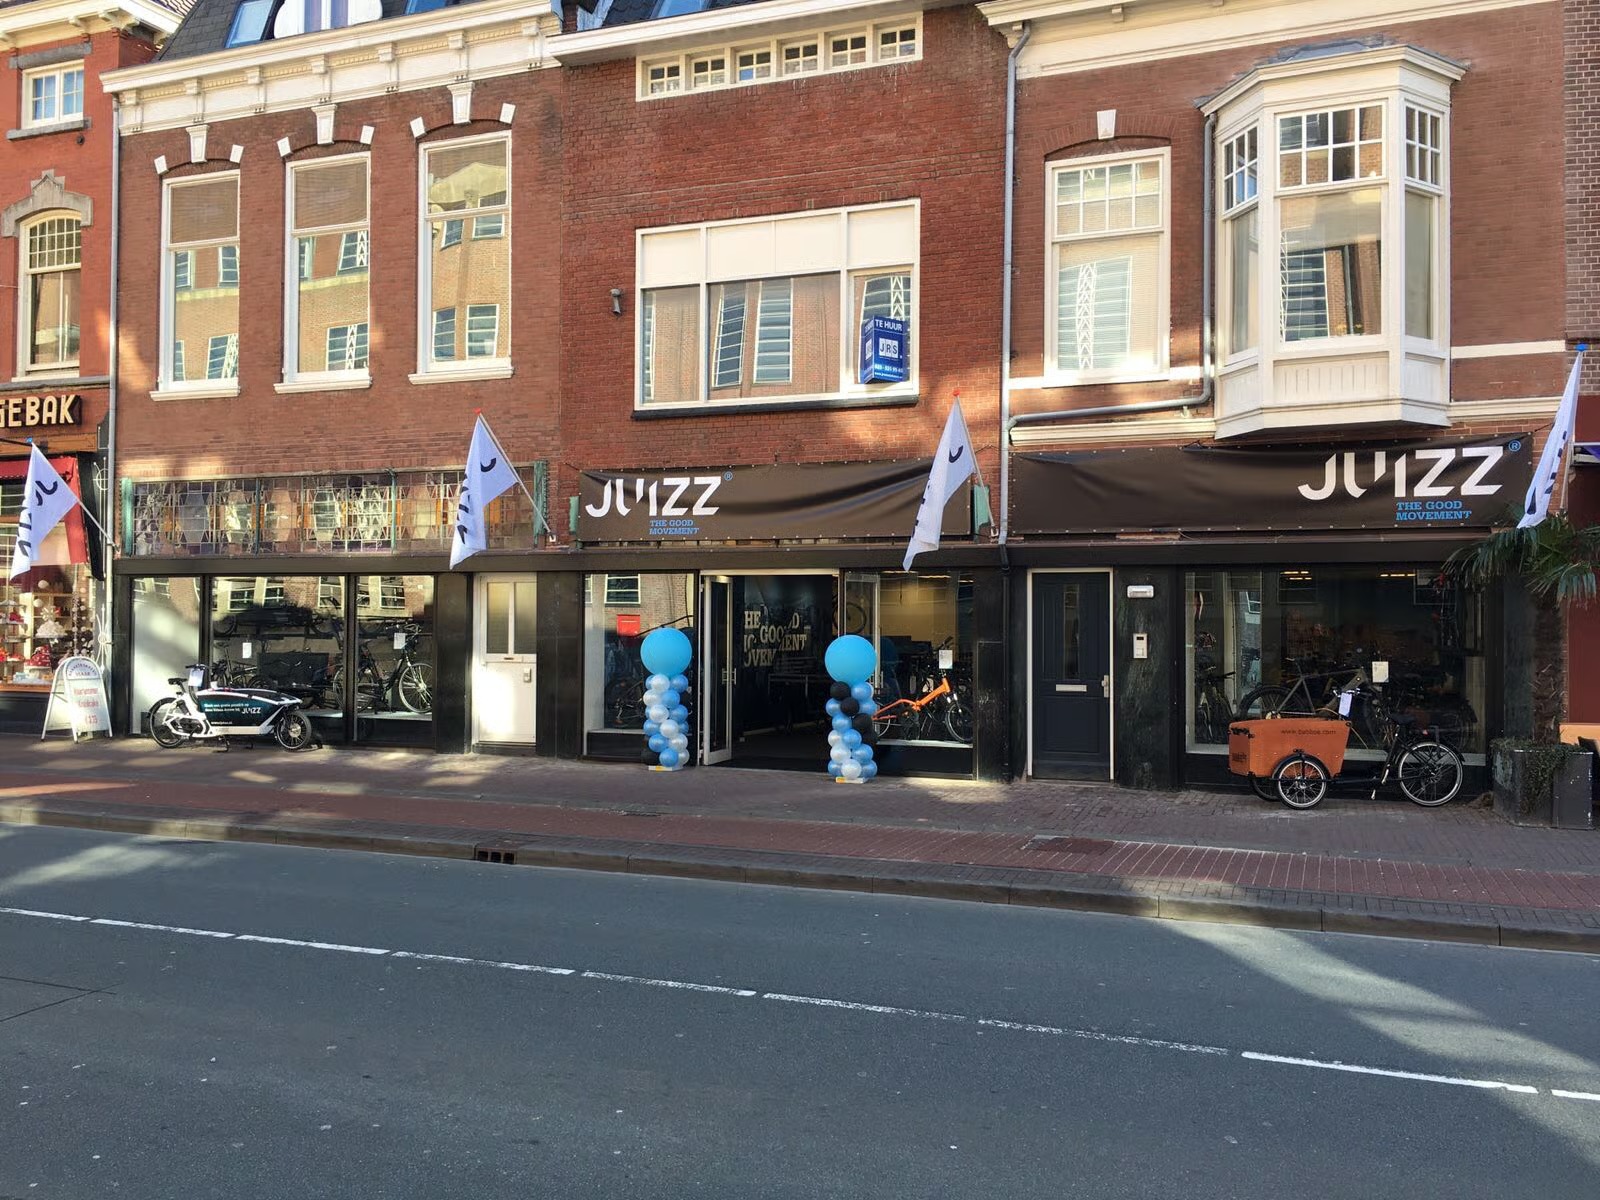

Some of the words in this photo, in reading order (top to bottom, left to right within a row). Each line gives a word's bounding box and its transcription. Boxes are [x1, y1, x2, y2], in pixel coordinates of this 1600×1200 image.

[875, 320, 883, 328] TE
[884, 321, 903, 332] HUUR
[1396, 501, 1422, 511] THE
[1425, 501, 1463, 510] GOOD
[1396, 511, 1472, 521] MOVEMENT
[650, 527, 700, 535] MOVEMENT
